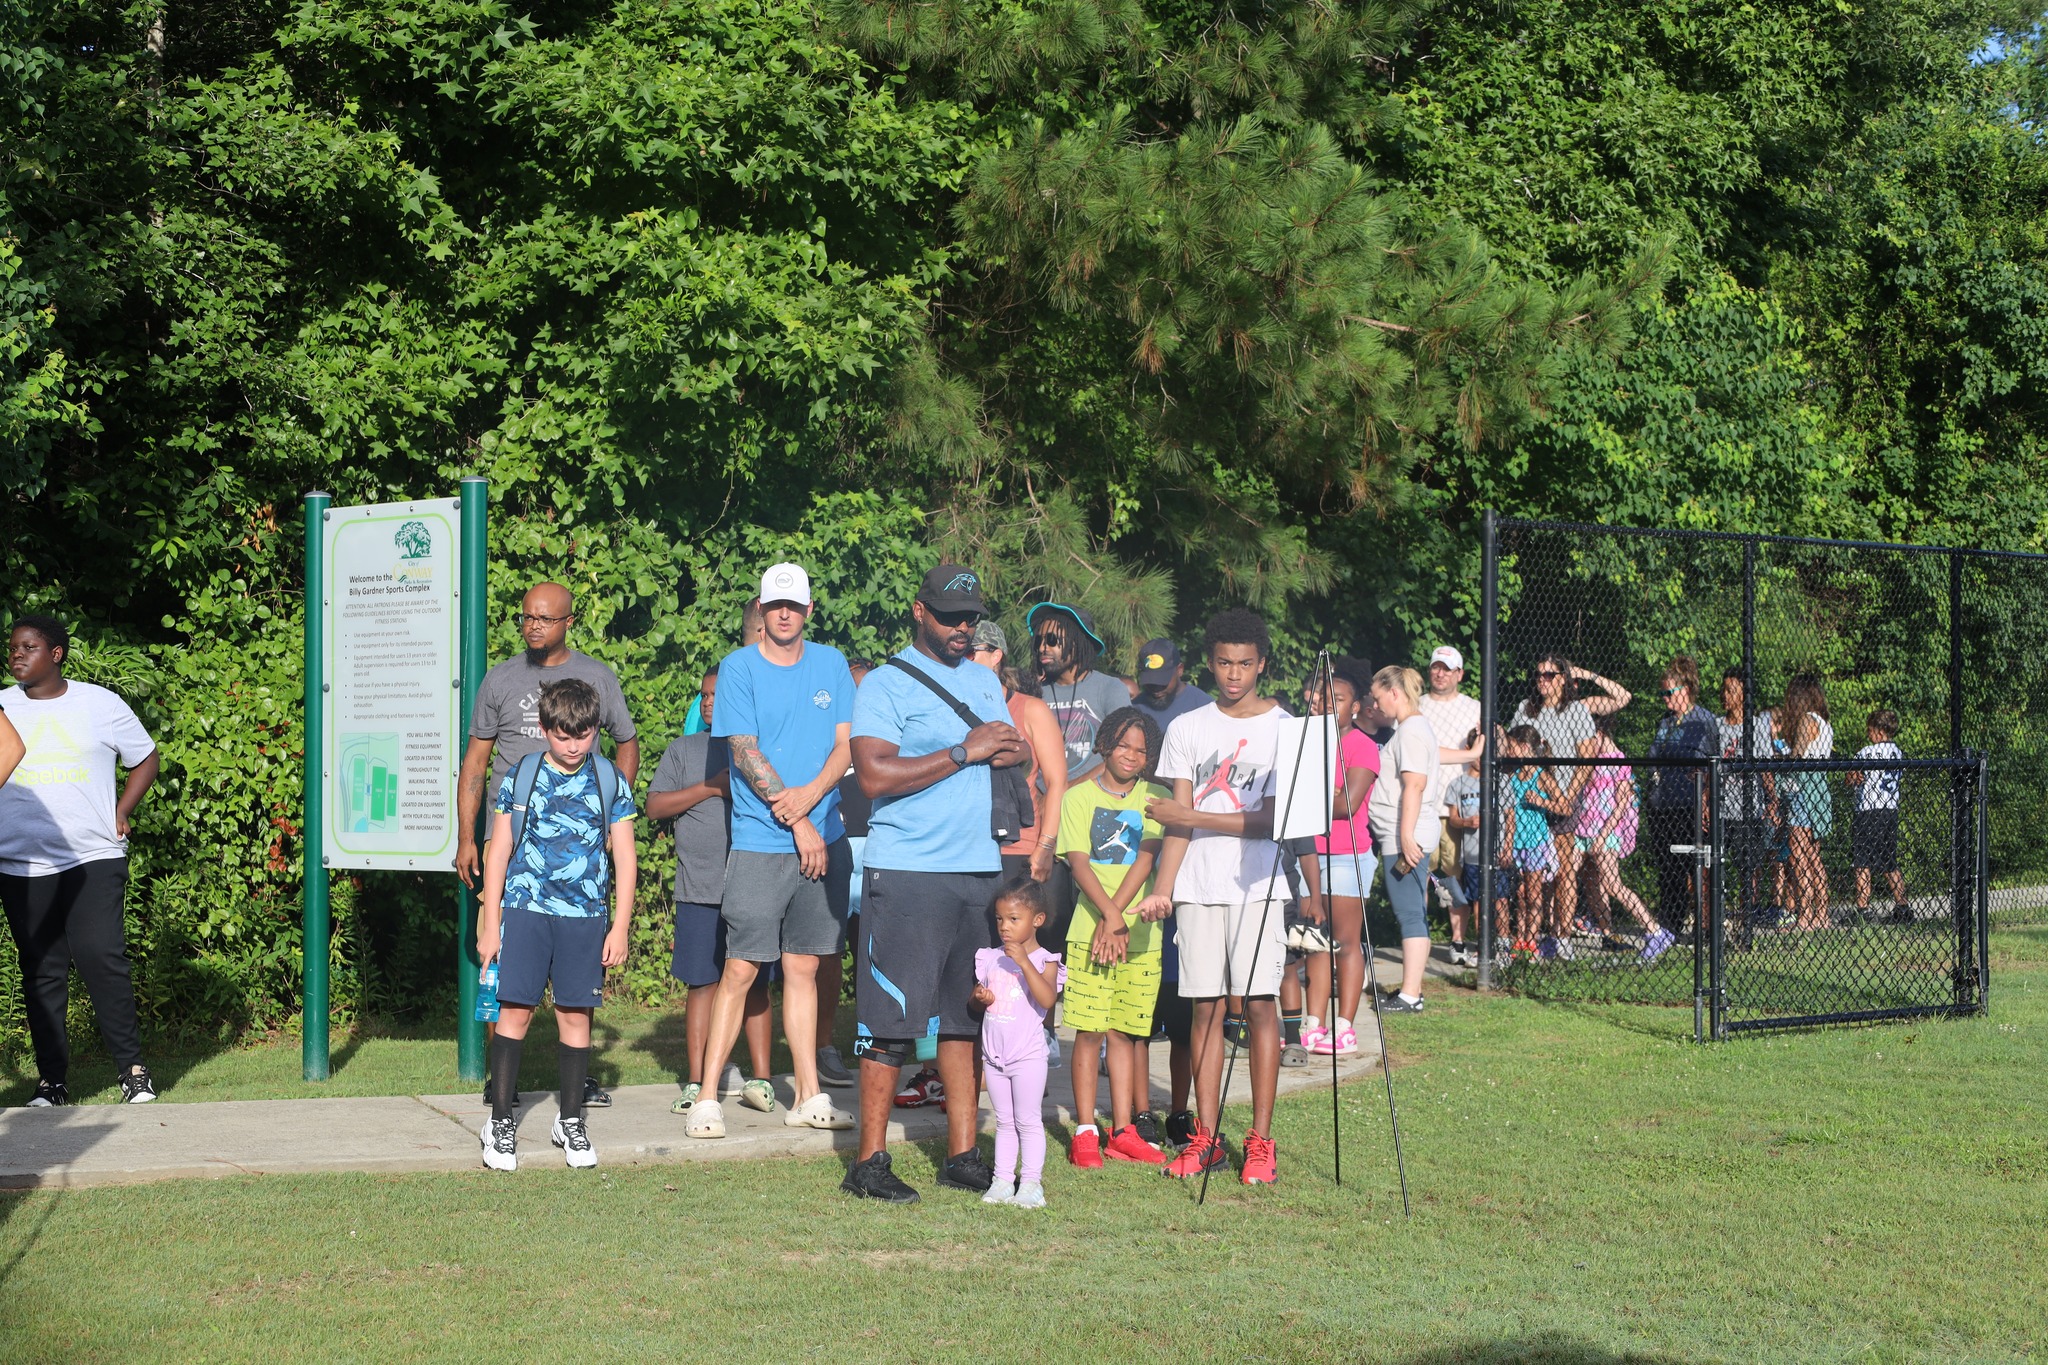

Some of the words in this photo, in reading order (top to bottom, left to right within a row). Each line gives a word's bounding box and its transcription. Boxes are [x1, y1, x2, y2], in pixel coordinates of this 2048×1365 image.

[349, 574, 375, 583] Welcome
[384, 573, 393, 582] the
[350, 588, 361, 596] Billy
[362, 587, 385, 596] Gardner
[386, 586, 404, 594] Sports
[406, 584, 430, 593] Complex
[519, 688, 543, 711] CL
[521, 726, 547, 739] FOO
[14, 766, 91, 785] Reebok
